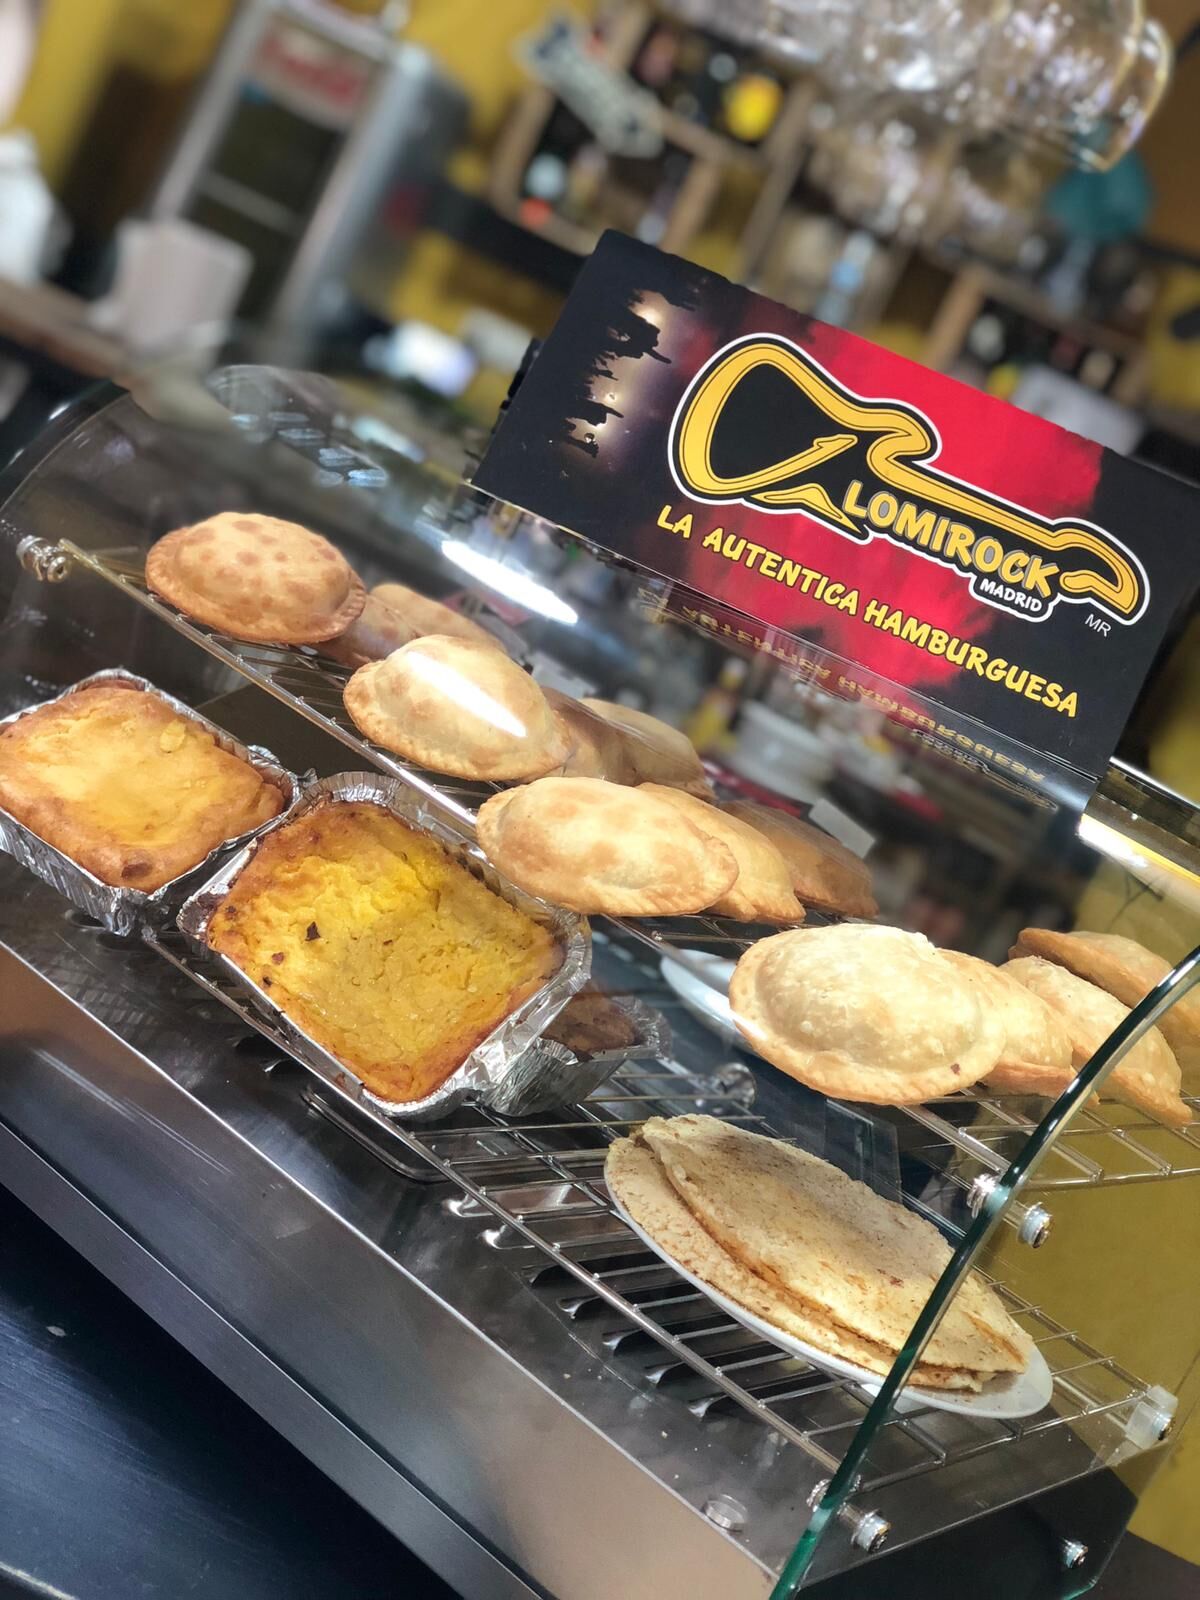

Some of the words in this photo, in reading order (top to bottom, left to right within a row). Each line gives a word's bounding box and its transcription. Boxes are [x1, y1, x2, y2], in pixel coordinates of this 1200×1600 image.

[843, 480, 1059, 599] LOMIROCK
[656, 504, 693, 539] LA
[702, 527, 860, 616] AUTENTICA
[864, 599, 1079, 718] HAMBURGUESA
[979, 577, 1043, 613] MADRID
[1084, 613, 1111, 637] MR
